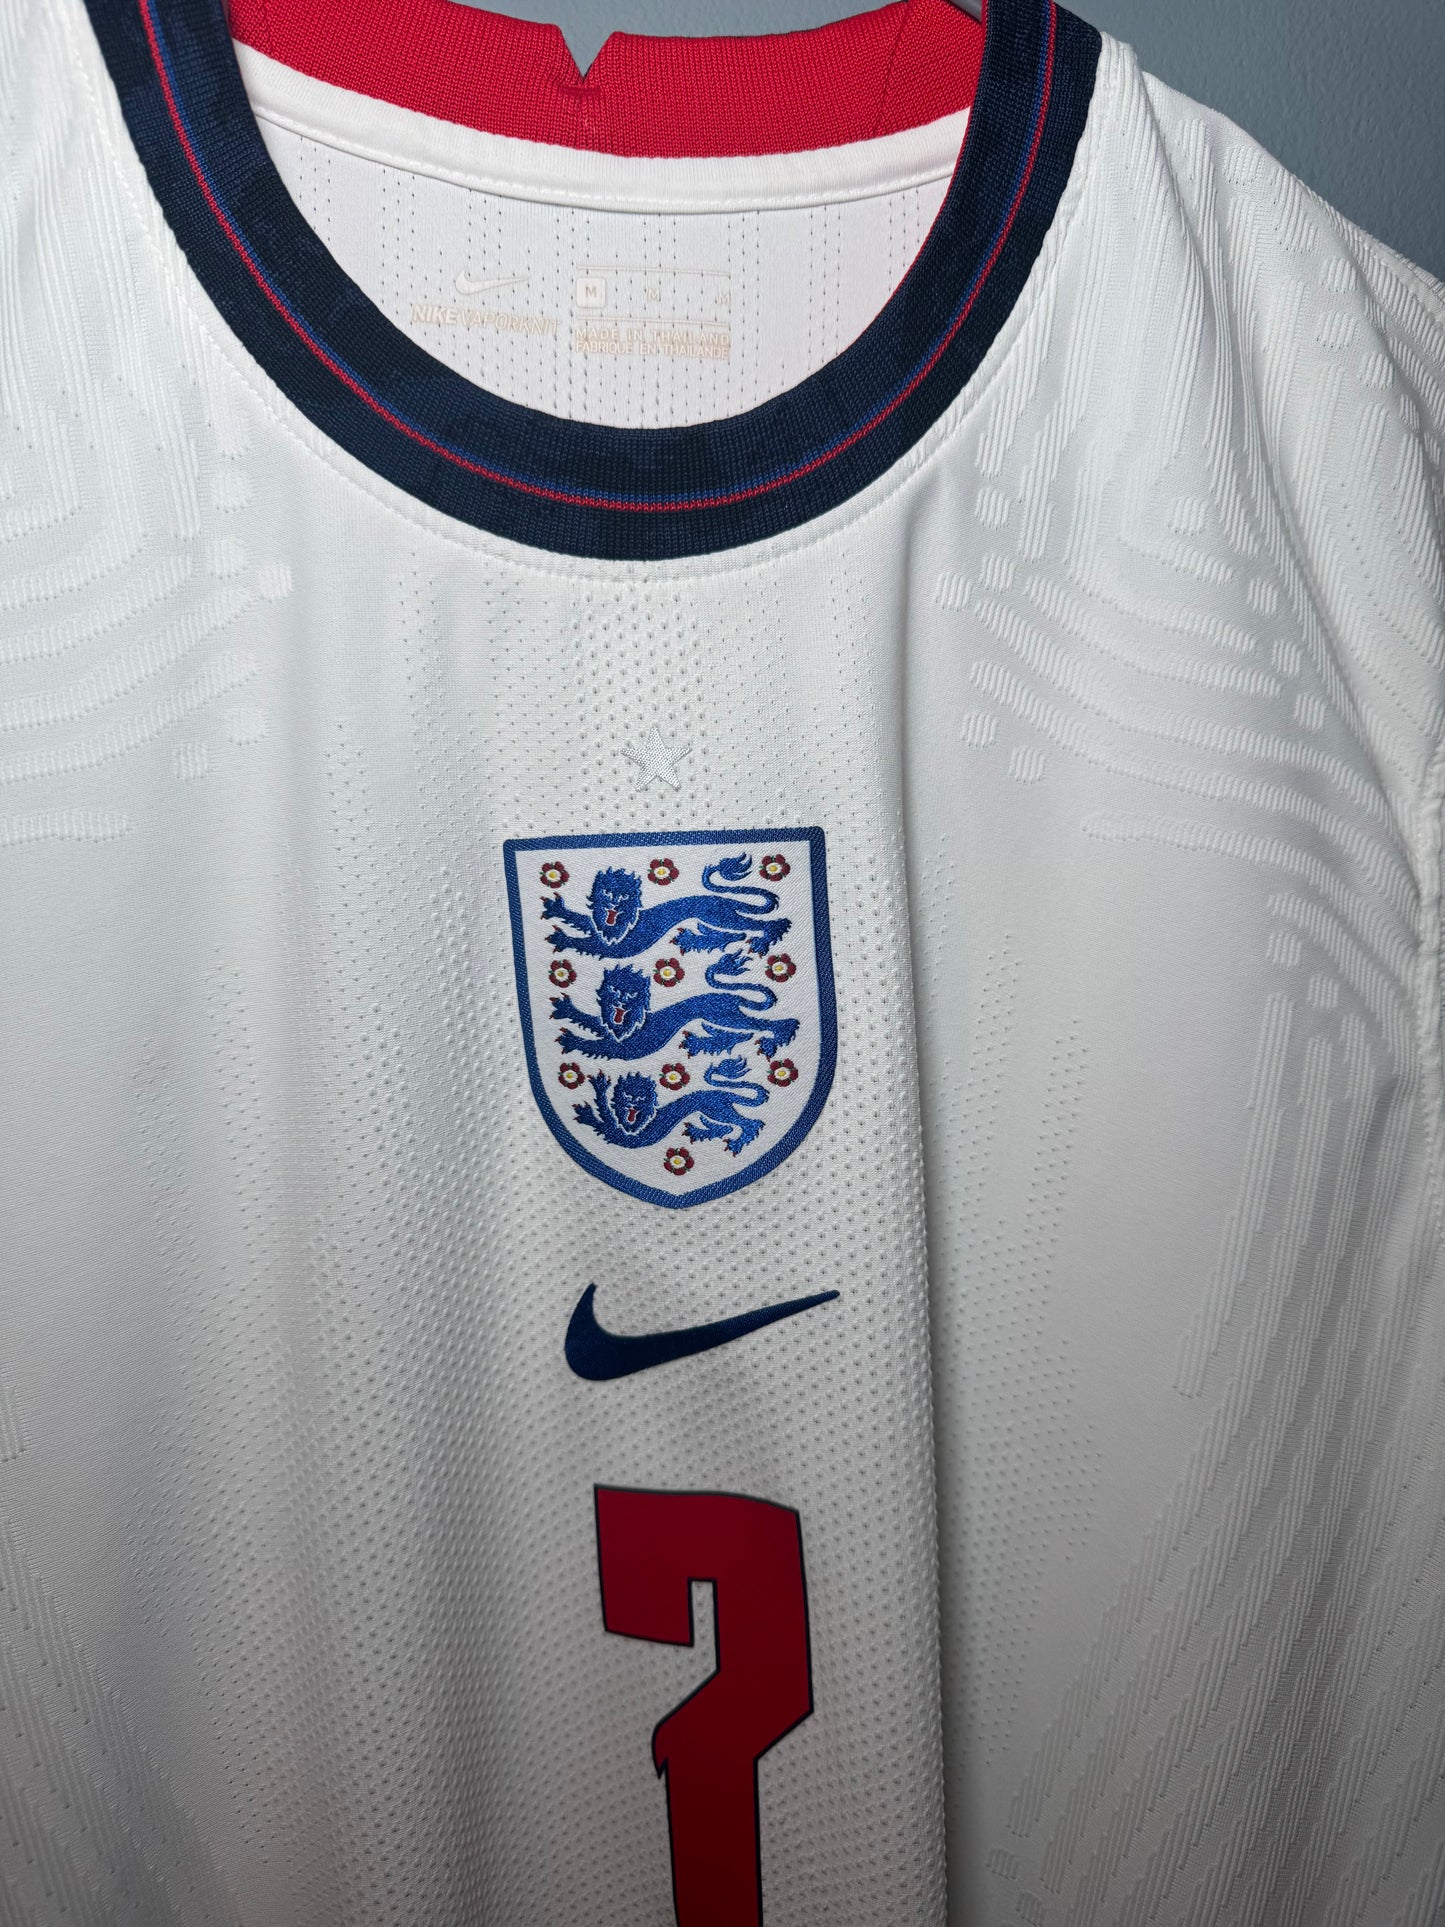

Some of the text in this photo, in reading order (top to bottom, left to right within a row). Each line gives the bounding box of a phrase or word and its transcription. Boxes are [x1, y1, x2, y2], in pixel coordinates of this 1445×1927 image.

[585, 285, 597, 298] M
[646, 287, 660, 302] M
[575, 327, 730, 346] MADE IN THAILAND
[575, 341, 729, 360] FABRIQUE EN THAILANDE
